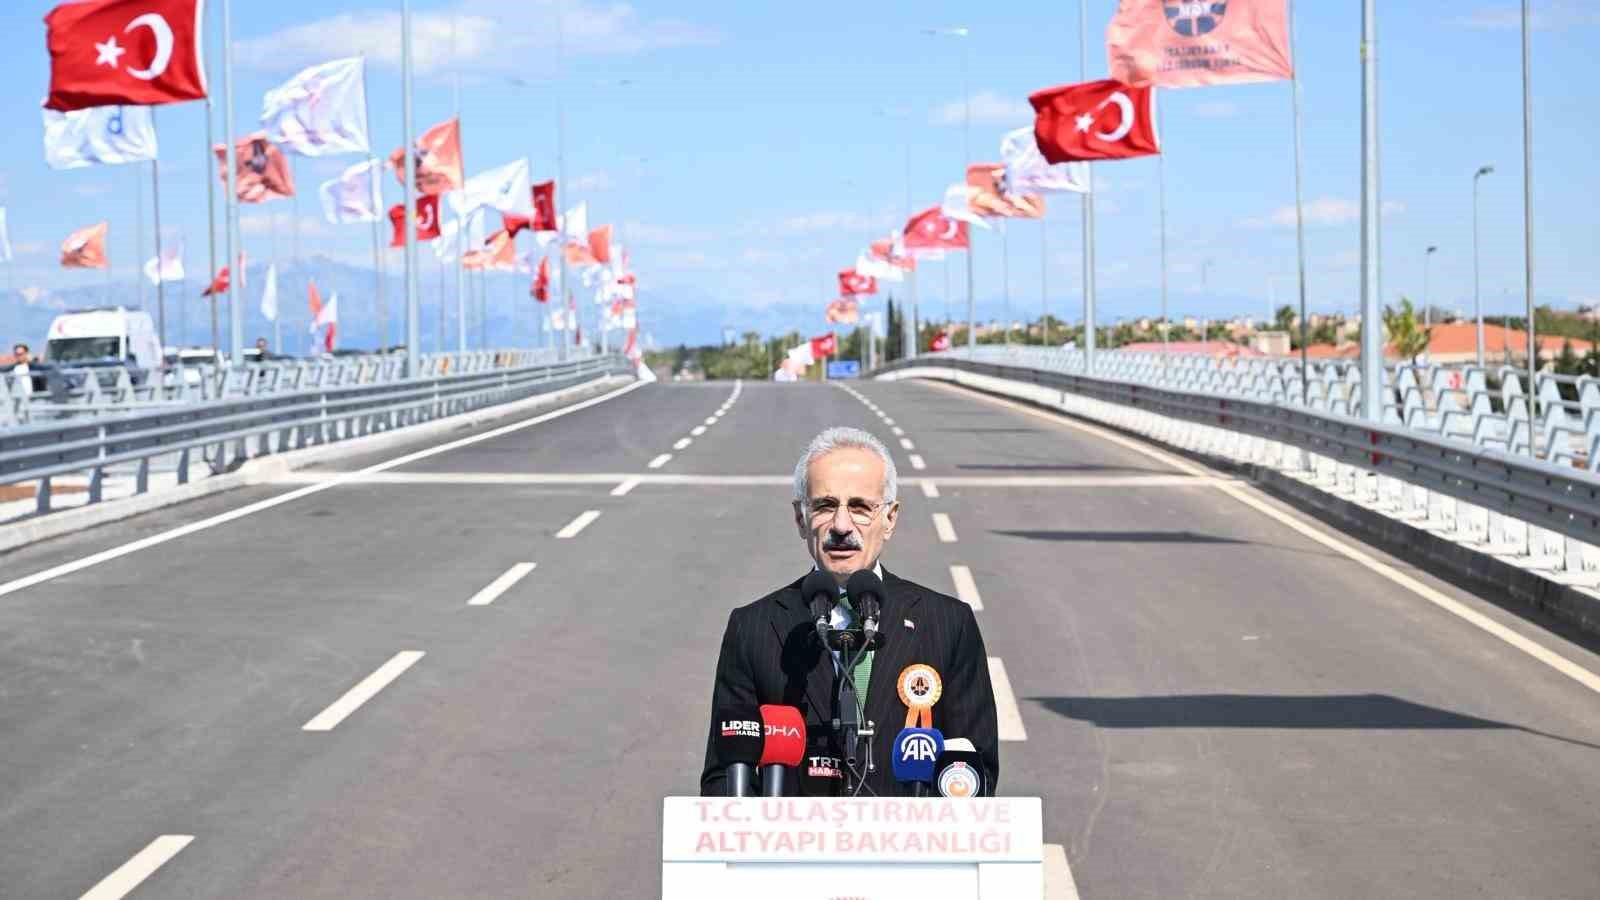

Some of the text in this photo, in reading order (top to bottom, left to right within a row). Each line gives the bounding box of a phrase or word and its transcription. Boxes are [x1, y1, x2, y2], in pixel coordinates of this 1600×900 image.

[902, 738, 936, 762] AA
[808, 756, 841, 768] TRT
[808, 767, 842, 779] HABER
[694, 800, 1011, 828] T.C. ULAŞTIRMA VE
[695, 831, 825, 852] ALTYAPI
